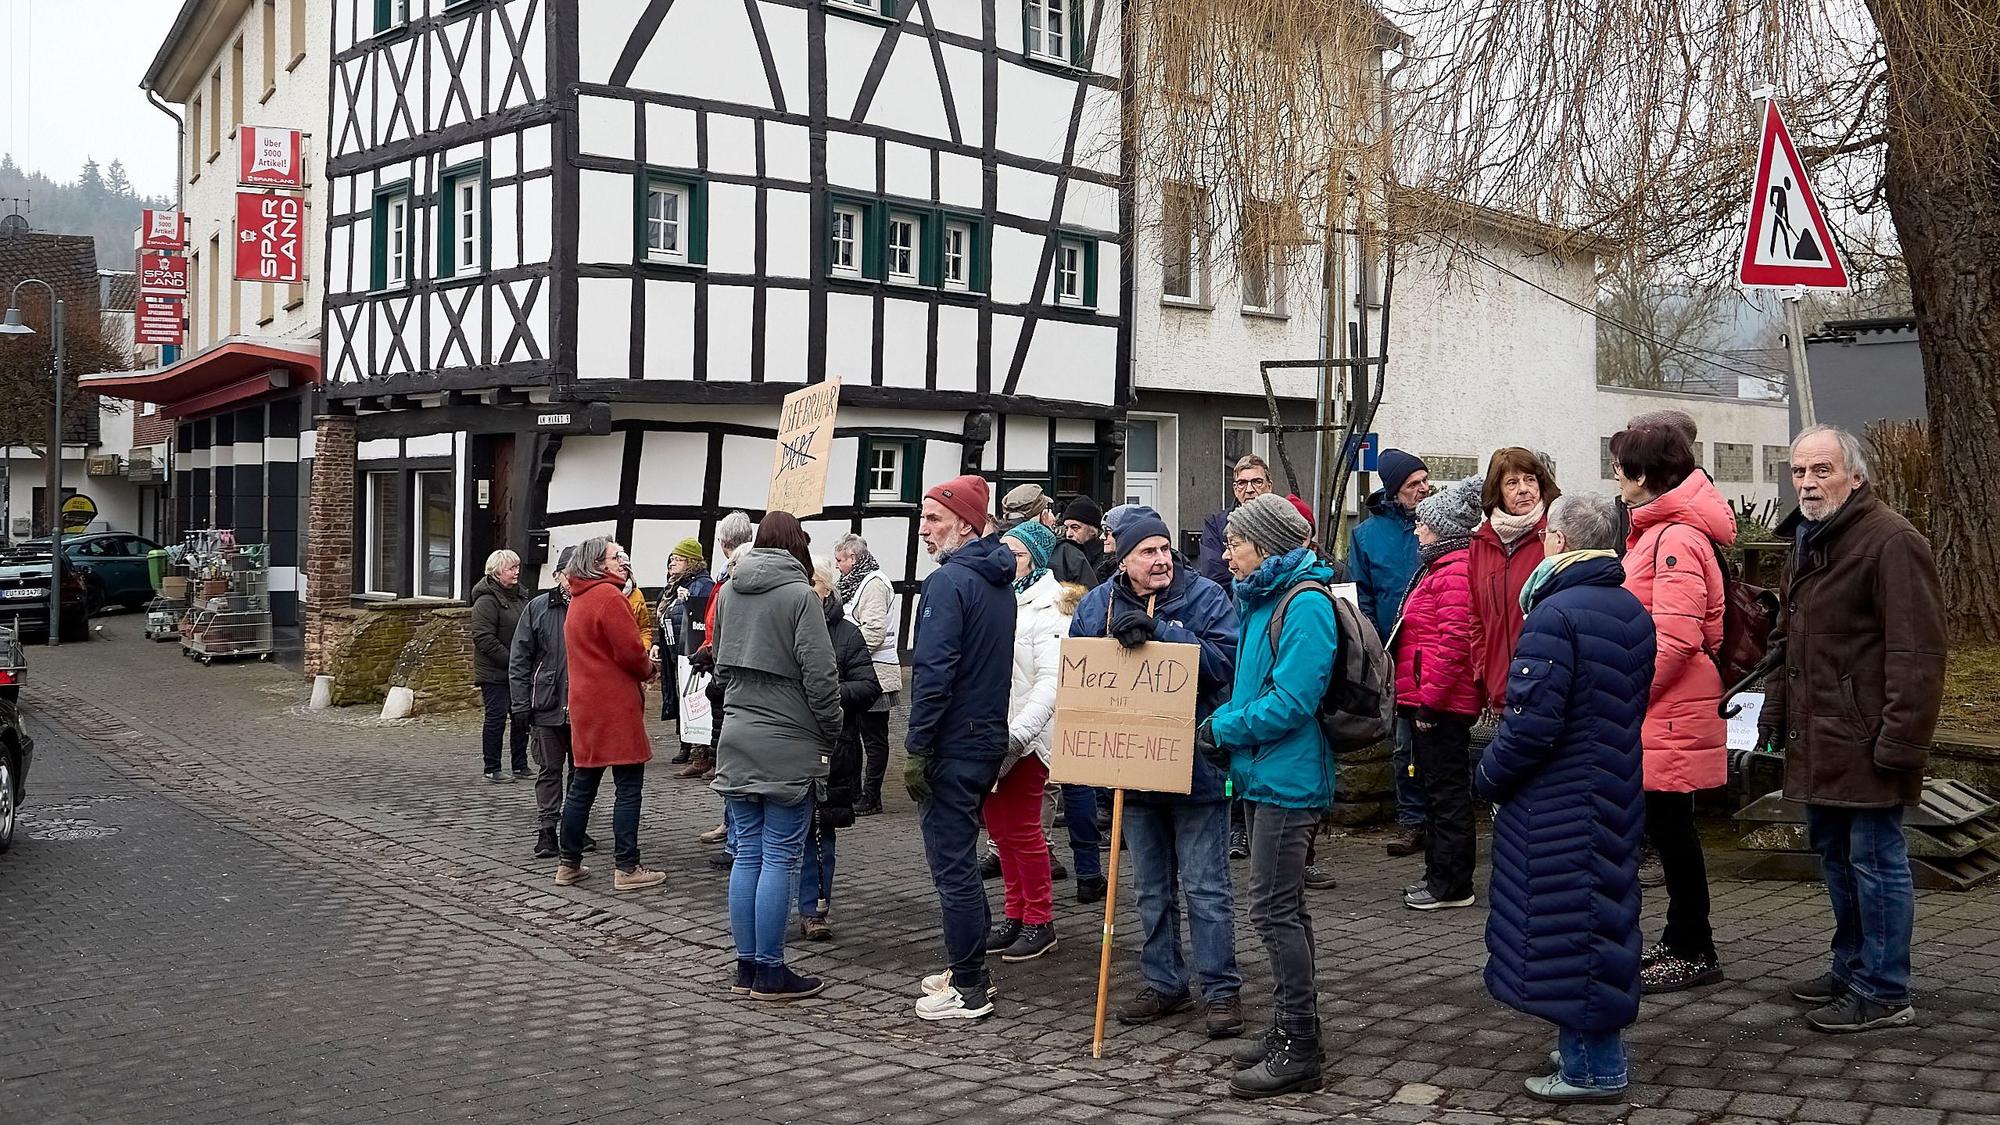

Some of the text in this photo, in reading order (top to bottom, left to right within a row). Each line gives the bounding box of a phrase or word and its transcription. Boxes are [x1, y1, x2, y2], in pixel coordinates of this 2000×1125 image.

[263, 138, 282, 148] Über
[263, 149, 281, 157] 5000
[258, 159, 287, 168] Artikel!
[261, 199, 278, 278] SPAR
[280, 199, 297, 280] LAND
[144, 270, 184, 279] SPAR
[143, 277, 185, 287] LAND
[1061, 654, 1118, 689] Merz
[1130, 659, 1189, 694] AfD
[1110, 696, 1129, 707] MIT
